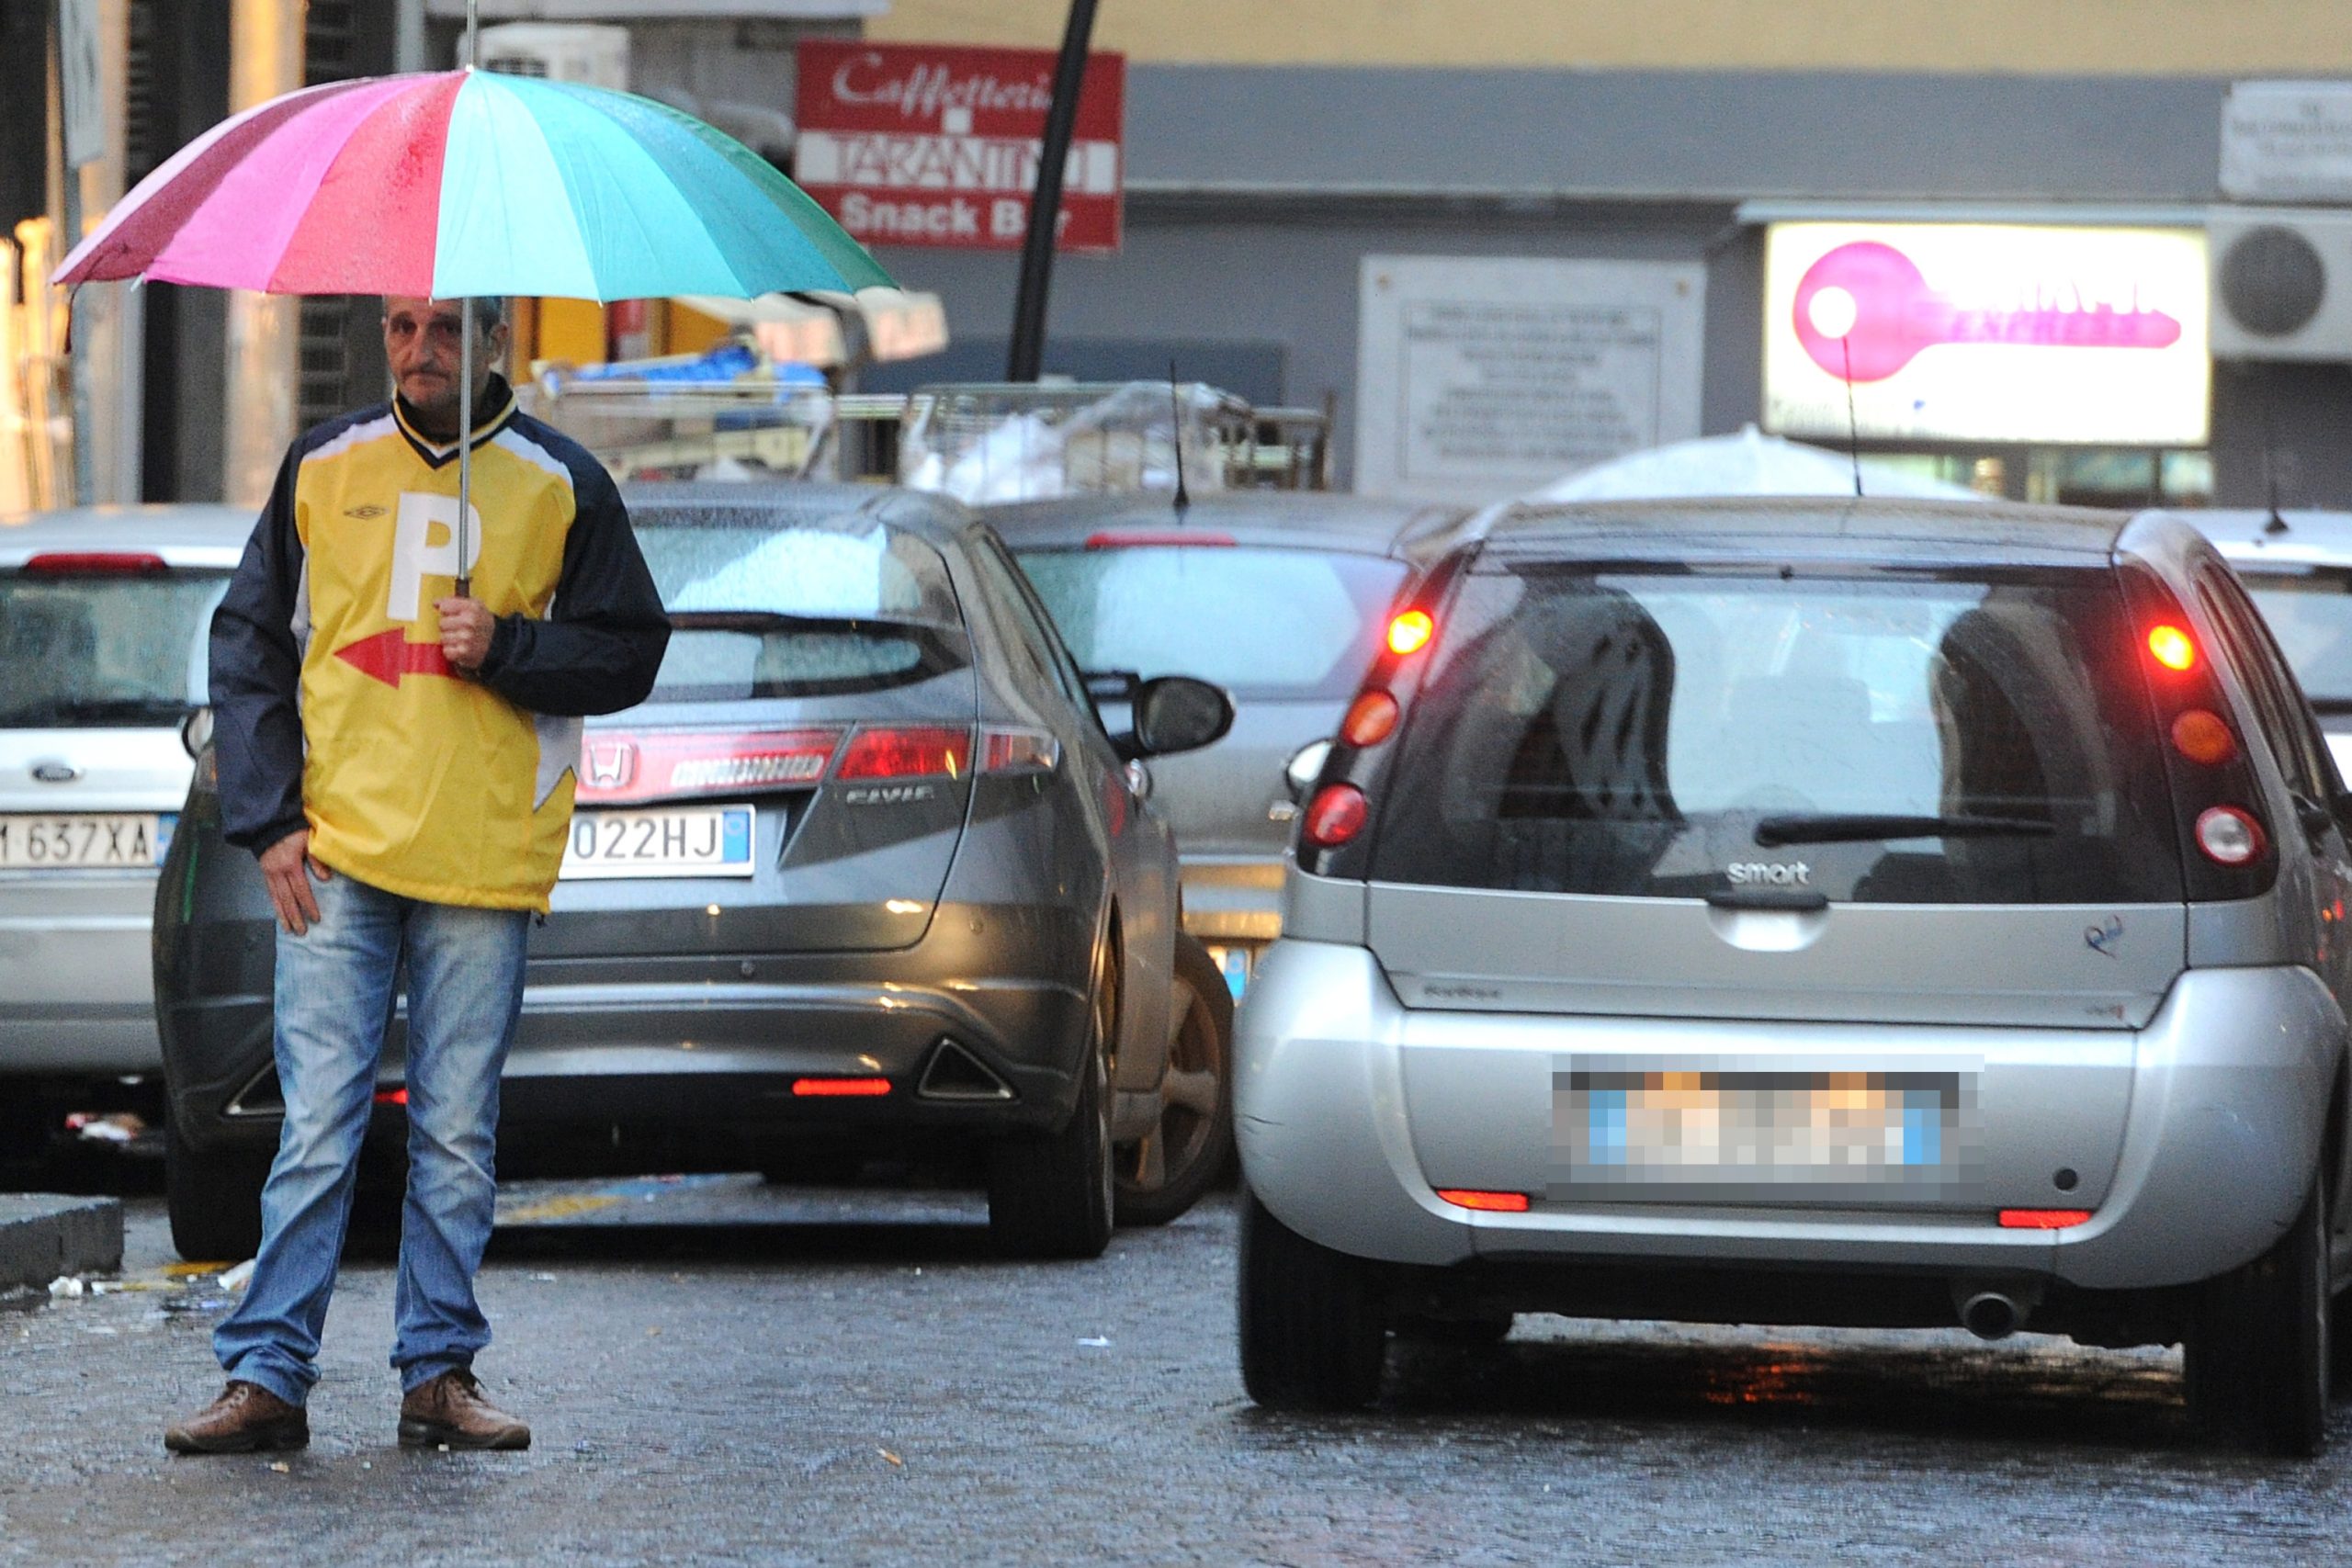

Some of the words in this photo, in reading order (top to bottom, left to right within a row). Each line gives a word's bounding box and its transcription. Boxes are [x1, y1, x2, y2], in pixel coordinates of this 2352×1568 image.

[832, 51, 1057, 117] Caffetteri
[840, 192, 979, 237] Snack
[991, 198, 1073, 241] Br
[387, 491, 481, 622] P
[1727, 861, 1810, 885] smart
